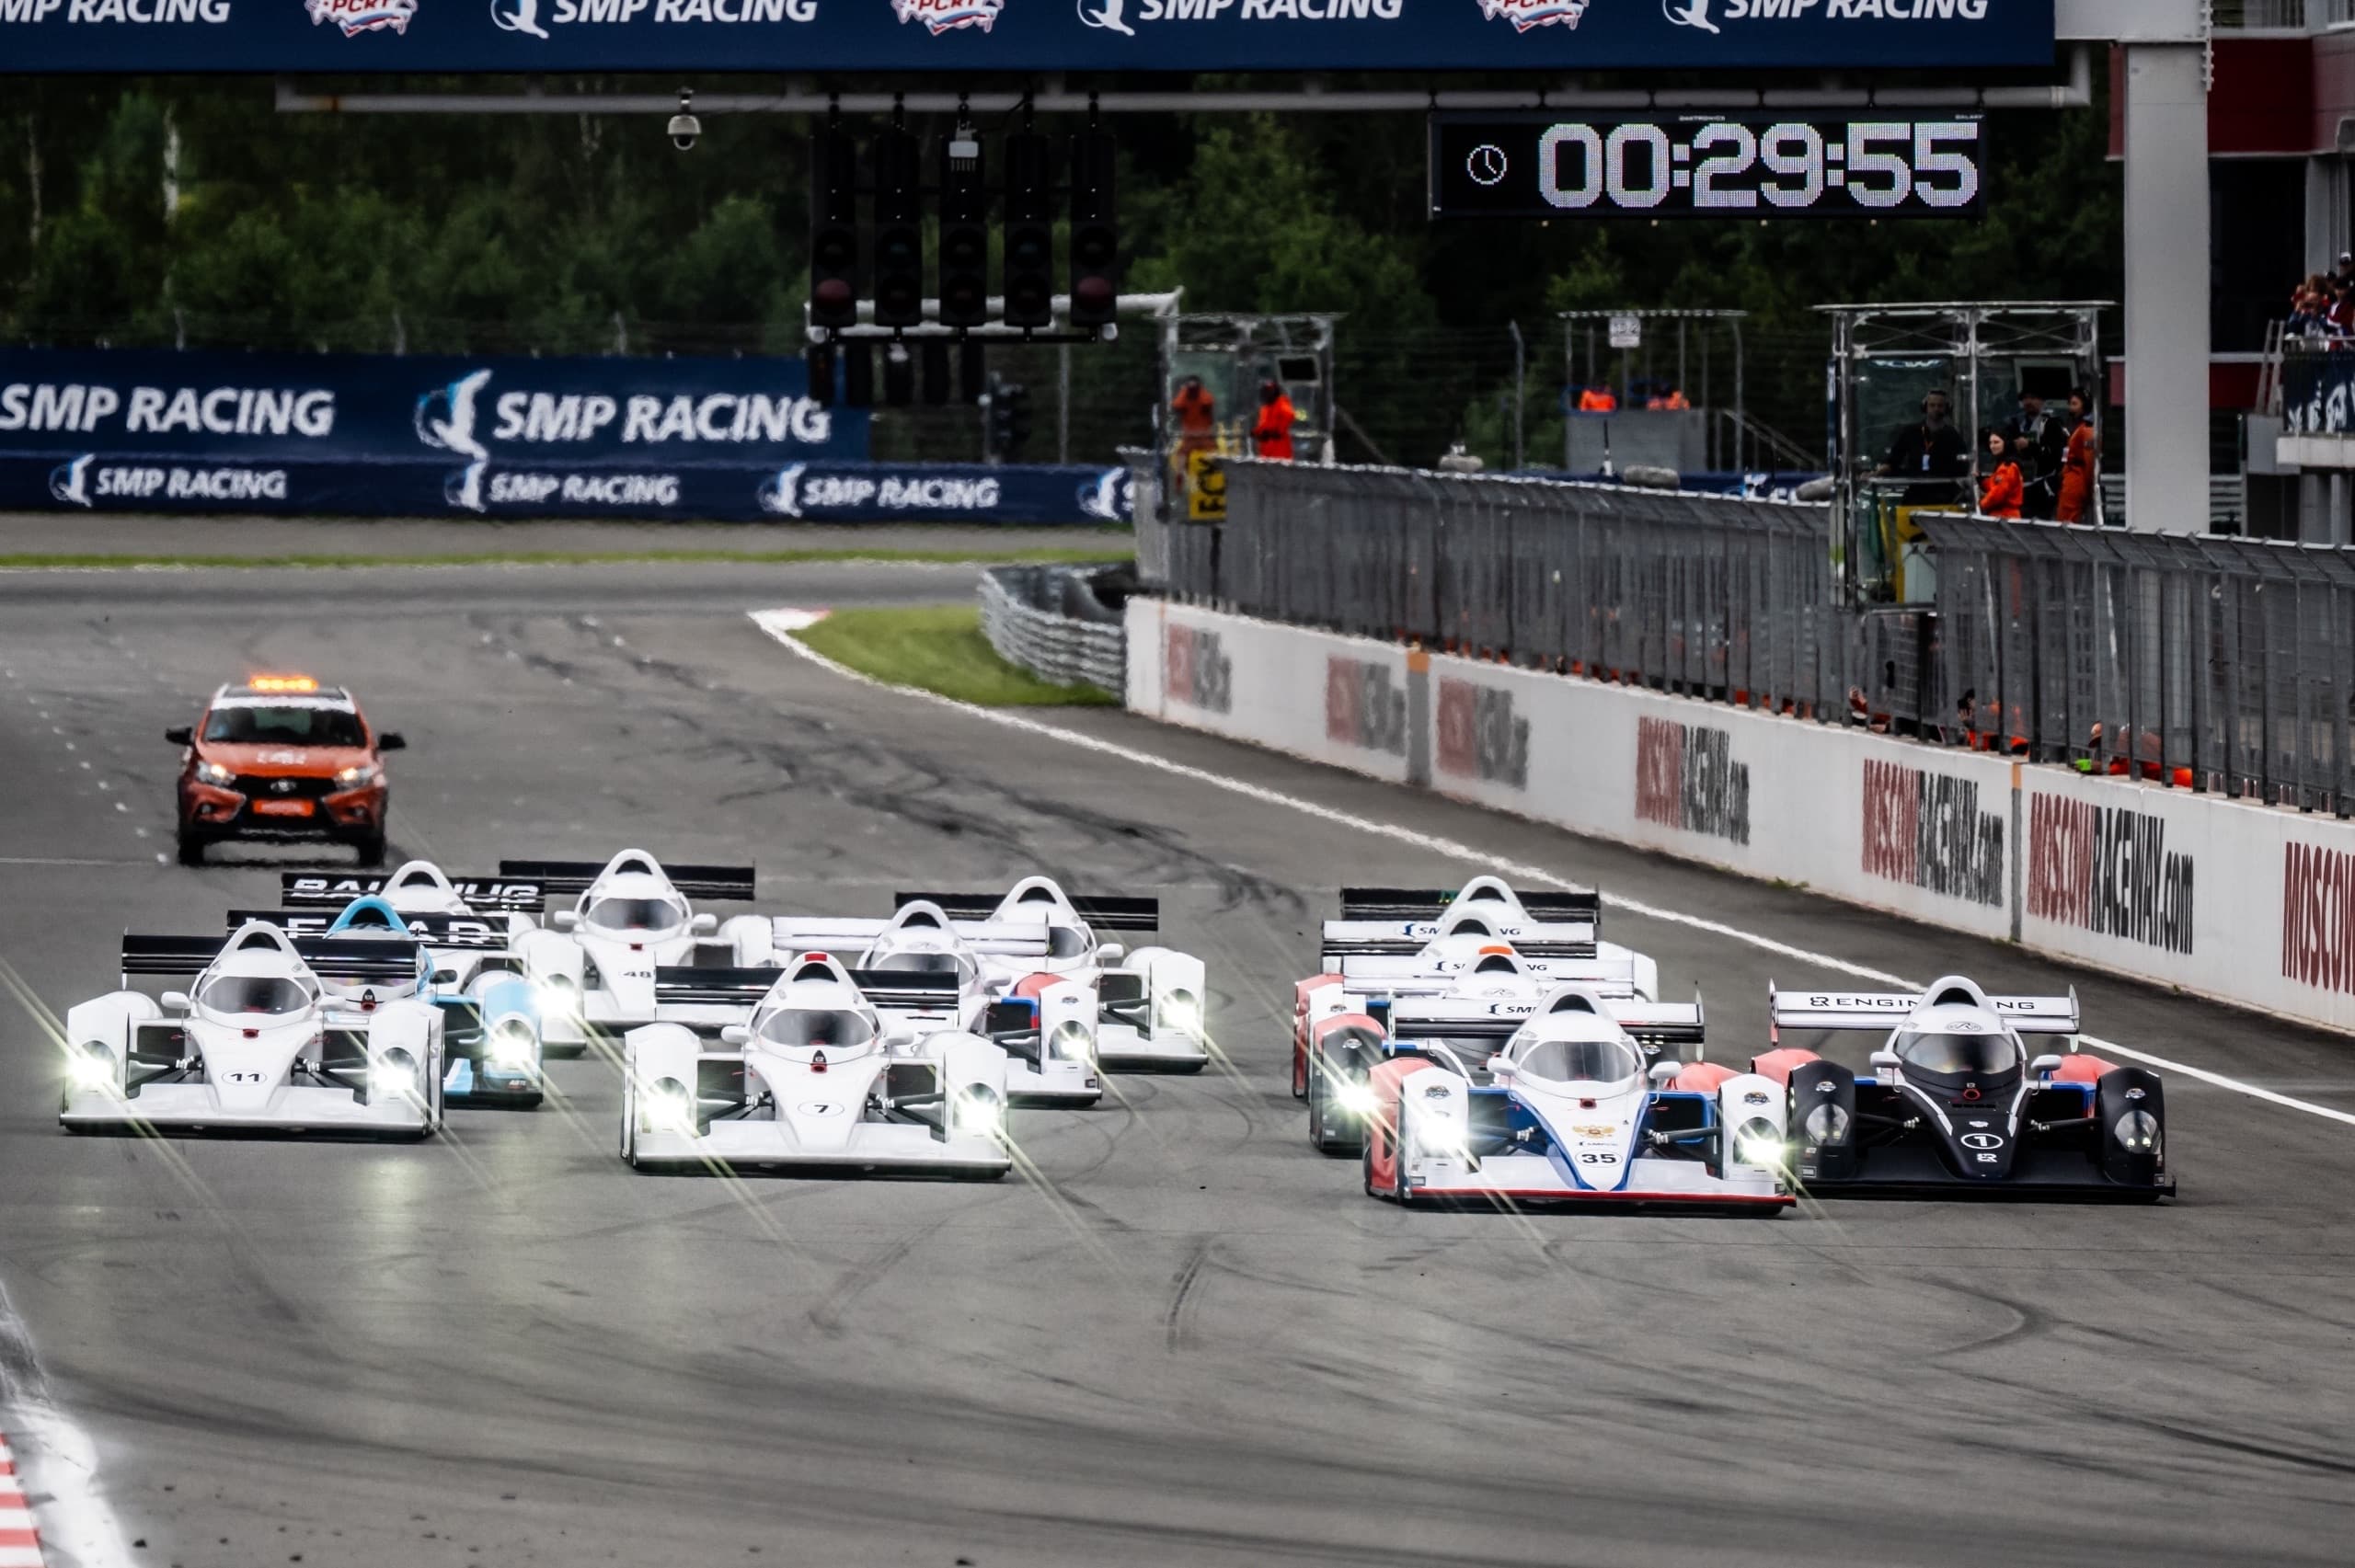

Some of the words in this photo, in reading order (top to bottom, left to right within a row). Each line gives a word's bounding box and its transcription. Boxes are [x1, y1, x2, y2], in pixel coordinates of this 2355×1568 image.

[67, 0, 230, 23] RACING
[552, 0, 648, 23] SMP
[654, 0, 818, 23] RACING
[1139, 0, 1235, 19] SMP
[1240, 0, 1403, 19] RACING
[1724, 0, 1818, 18] SMP
[1826, 0, 1988, 18] RACING
[1539, 123, 1978, 207] 00:29:55
[0, 383, 120, 431] SMP
[126, 386, 335, 437] RACING
[492, 392, 616, 442] SMP
[621, 394, 832, 443] RACING
[95, 466, 165, 497] SMP
[167, 469, 287, 499] RACING
[489, 473, 559, 502] SMP
[561, 474, 679, 505] RACING
[802, 476, 875, 507] SMP
[877, 478, 1000, 509] RACING
[230, 1072, 259, 1082] 11
[813, 1104, 829, 1114] 7
[1973, 1136, 1988, 1147] 1
[1581, 1153, 1616, 1163] 35
